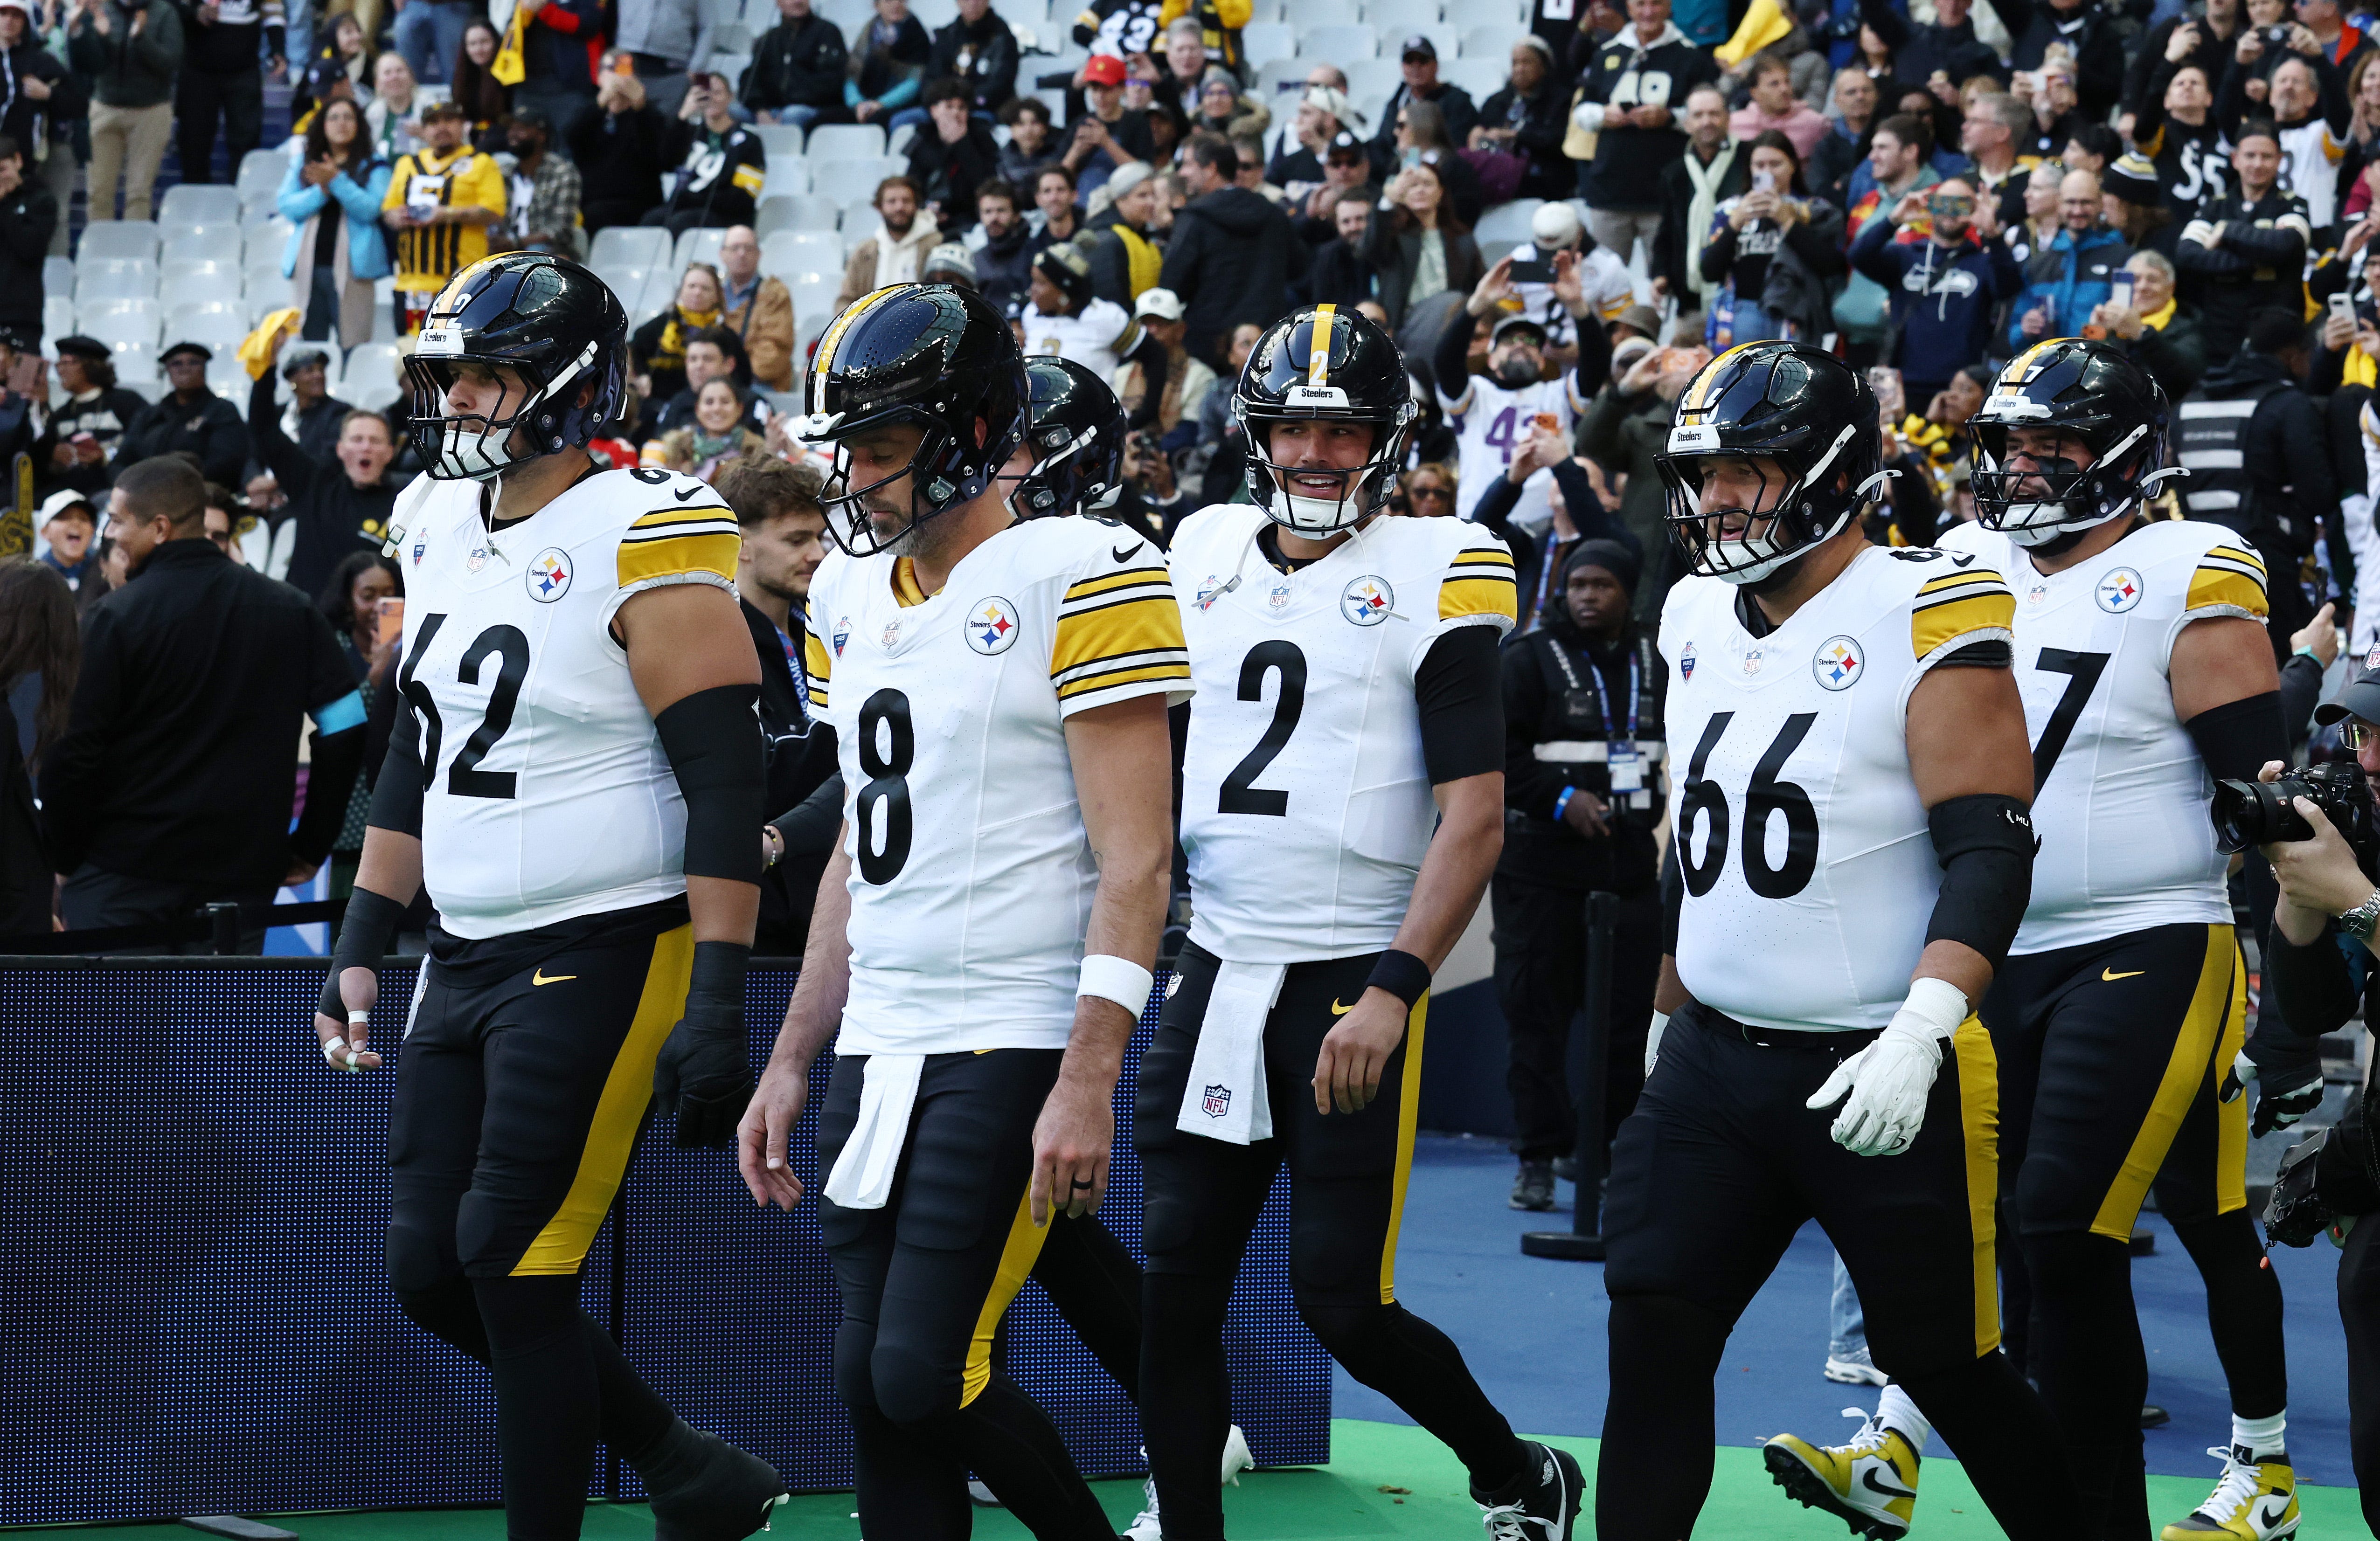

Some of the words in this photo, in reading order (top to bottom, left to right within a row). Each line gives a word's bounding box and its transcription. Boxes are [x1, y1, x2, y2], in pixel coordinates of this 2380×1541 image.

[1308, 350, 1328, 386] 2
[814, 372, 826, 413] 8
[1301, 388, 1333, 398] Steelers
[1992, 399, 2017, 408] Steelers
[1677, 430, 1701, 442] Steelers
[469, 557, 483, 568] NFL
[1272, 594, 1287, 605] NFL
[1347, 594, 1366, 602] Steelers
[2030, 593, 2043, 602] NFL
[970, 620, 991, 629] Steelers
[884, 630, 899, 643] NFL
[1746, 659, 1760, 670] NFL
[399, 613, 530, 799] 62
[1218, 640, 1308, 817] 2
[856, 688, 915, 885] 8
[1678, 711, 1819, 899] 66
[1205, 1097, 1224, 1113] NFL
